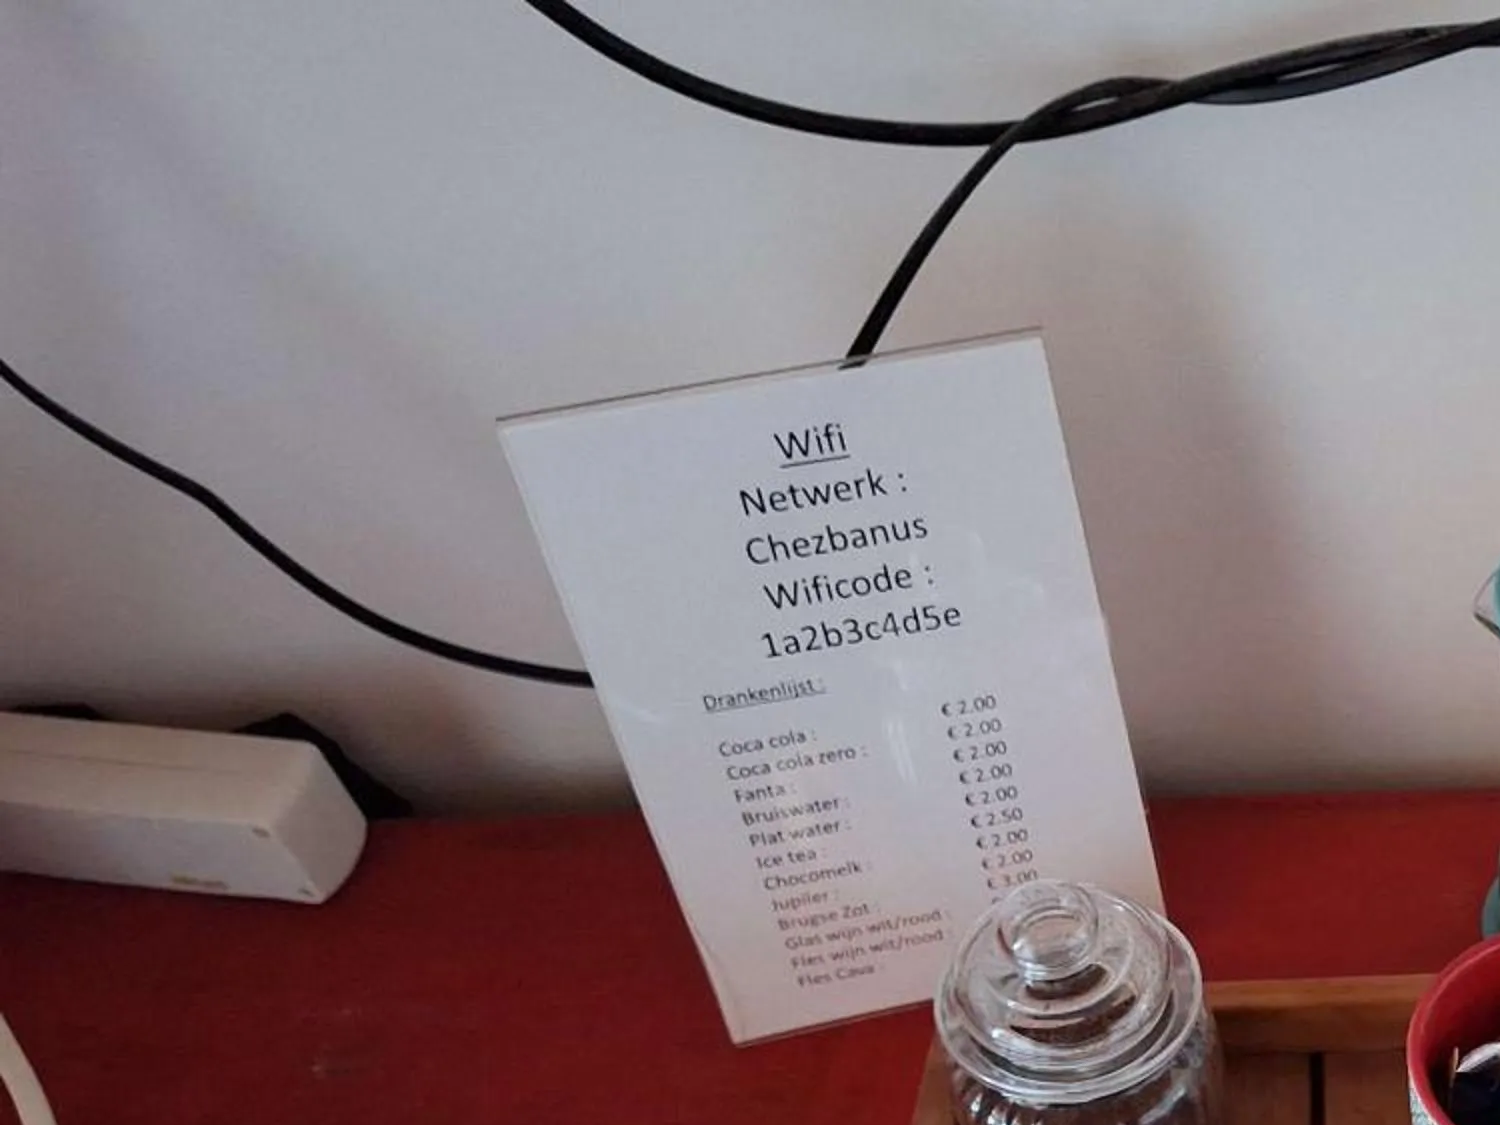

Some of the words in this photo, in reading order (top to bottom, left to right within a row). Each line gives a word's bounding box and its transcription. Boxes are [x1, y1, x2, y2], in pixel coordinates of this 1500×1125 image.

[774, 423, 847, 461] Wifi
[739, 469, 888, 516] Netwerk
[745, 516, 928, 565] Chezbanus
[763, 564, 913, 610] Wificode
[761, 605, 962, 658] 1a2b3c4d5e
[703, 679, 817, 712] Drankenlijst
[960, 695, 996, 714] 2.00
[964, 718, 1002, 737] 2.00
[718, 739, 764, 757] Coca
[769, 729, 807, 749] cola
[970, 740, 1007, 760] 2.00
[726, 763, 772, 780] Coca
[776, 754, 815, 771] cola
[818, 747, 857, 765] zero
[976, 763, 1013, 783] 2.00
[734, 784, 786, 803] Fanta
[981, 785, 1018, 804] 2.00
[742, 799, 840, 826] Bruiswater
[986, 807, 1023, 826] 2.50
[749, 830, 785, 847] Plat
[788, 820, 841, 840] water
[992, 829, 1028, 847] 2.00
[756, 854, 783, 870] Ice
[787, 849, 818, 865] tea
[763, 861, 863, 890] Chocomelk
